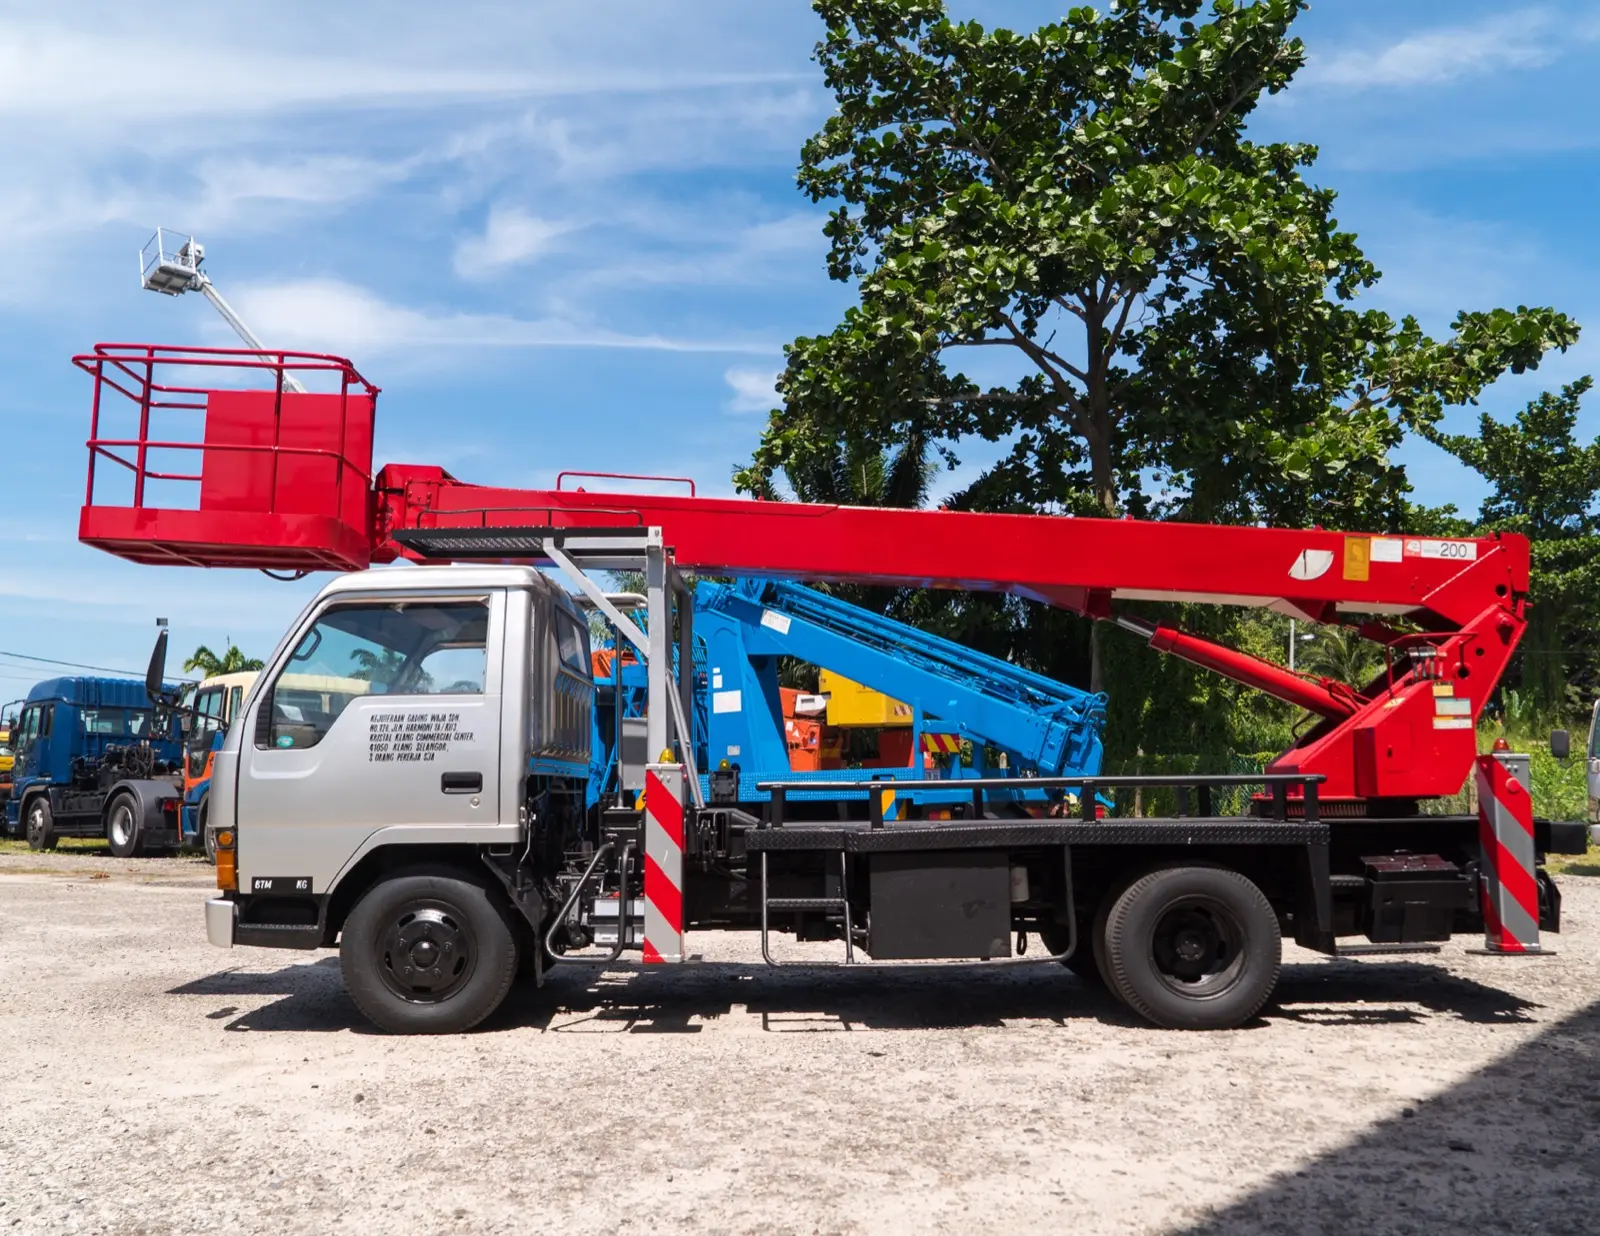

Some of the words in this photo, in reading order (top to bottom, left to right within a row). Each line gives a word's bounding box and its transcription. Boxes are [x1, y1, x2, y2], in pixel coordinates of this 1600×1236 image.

[1440, 543, 1467, 557] 200
[369, 733, 392, 742] KRISTAL
[394, 733, 414, 742] KLANG
[415, 732, 452, 742] COMMERCIAL
[369, 743, 389, 752] 41050
[392, 743, 413, 752] KLANG
[374, 752, 394, 762] ORANG
[254, 879, 272, 889] BTM
[296, 879, 308, 889] KG
